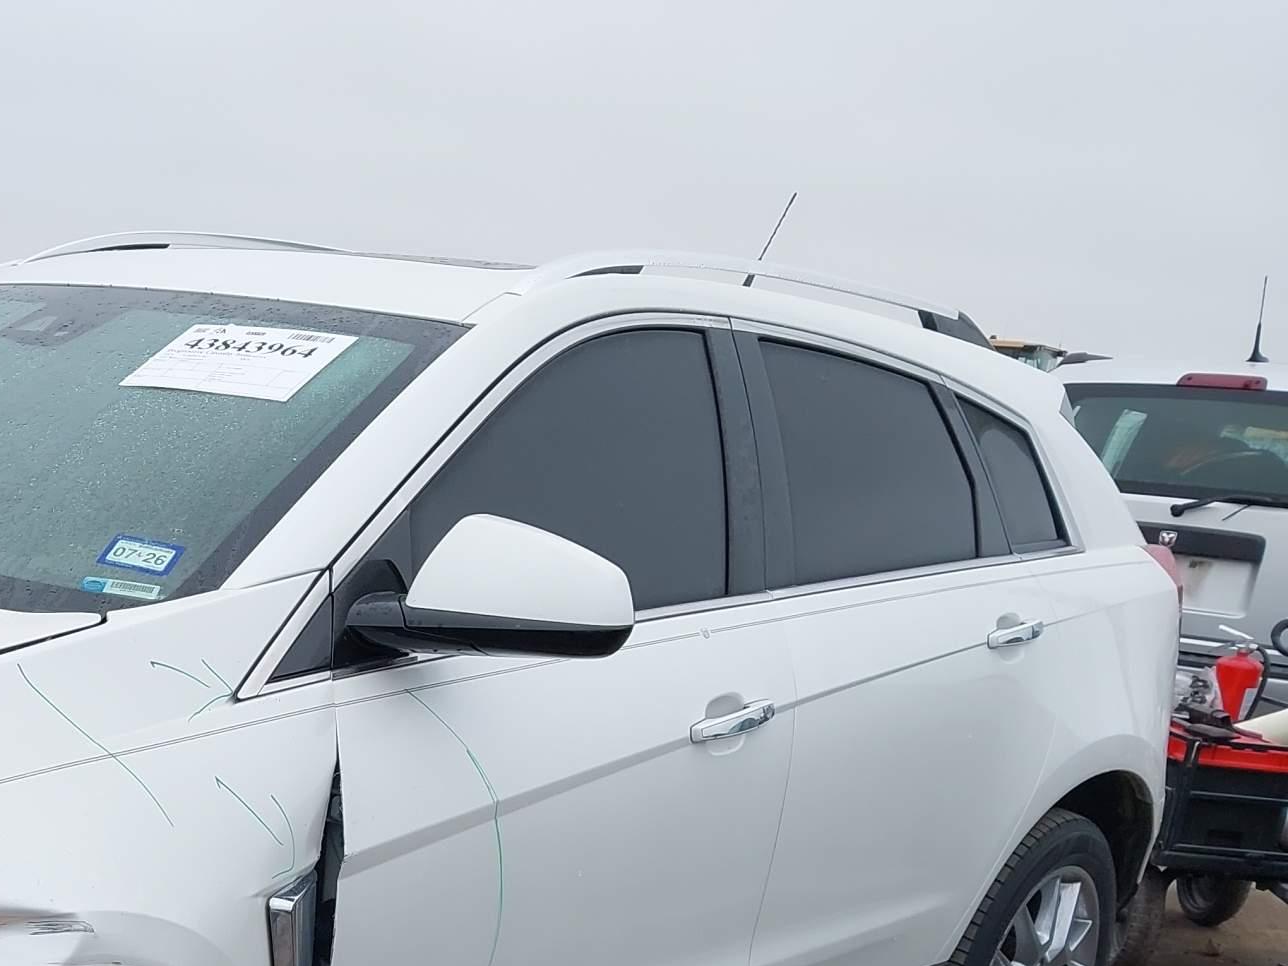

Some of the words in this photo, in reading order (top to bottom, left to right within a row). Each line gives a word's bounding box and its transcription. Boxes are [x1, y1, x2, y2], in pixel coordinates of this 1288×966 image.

[184, 337, 319, 359] 43843964
[112, 546, 138, 560] 07
[141, 552, 168, 566] 26
